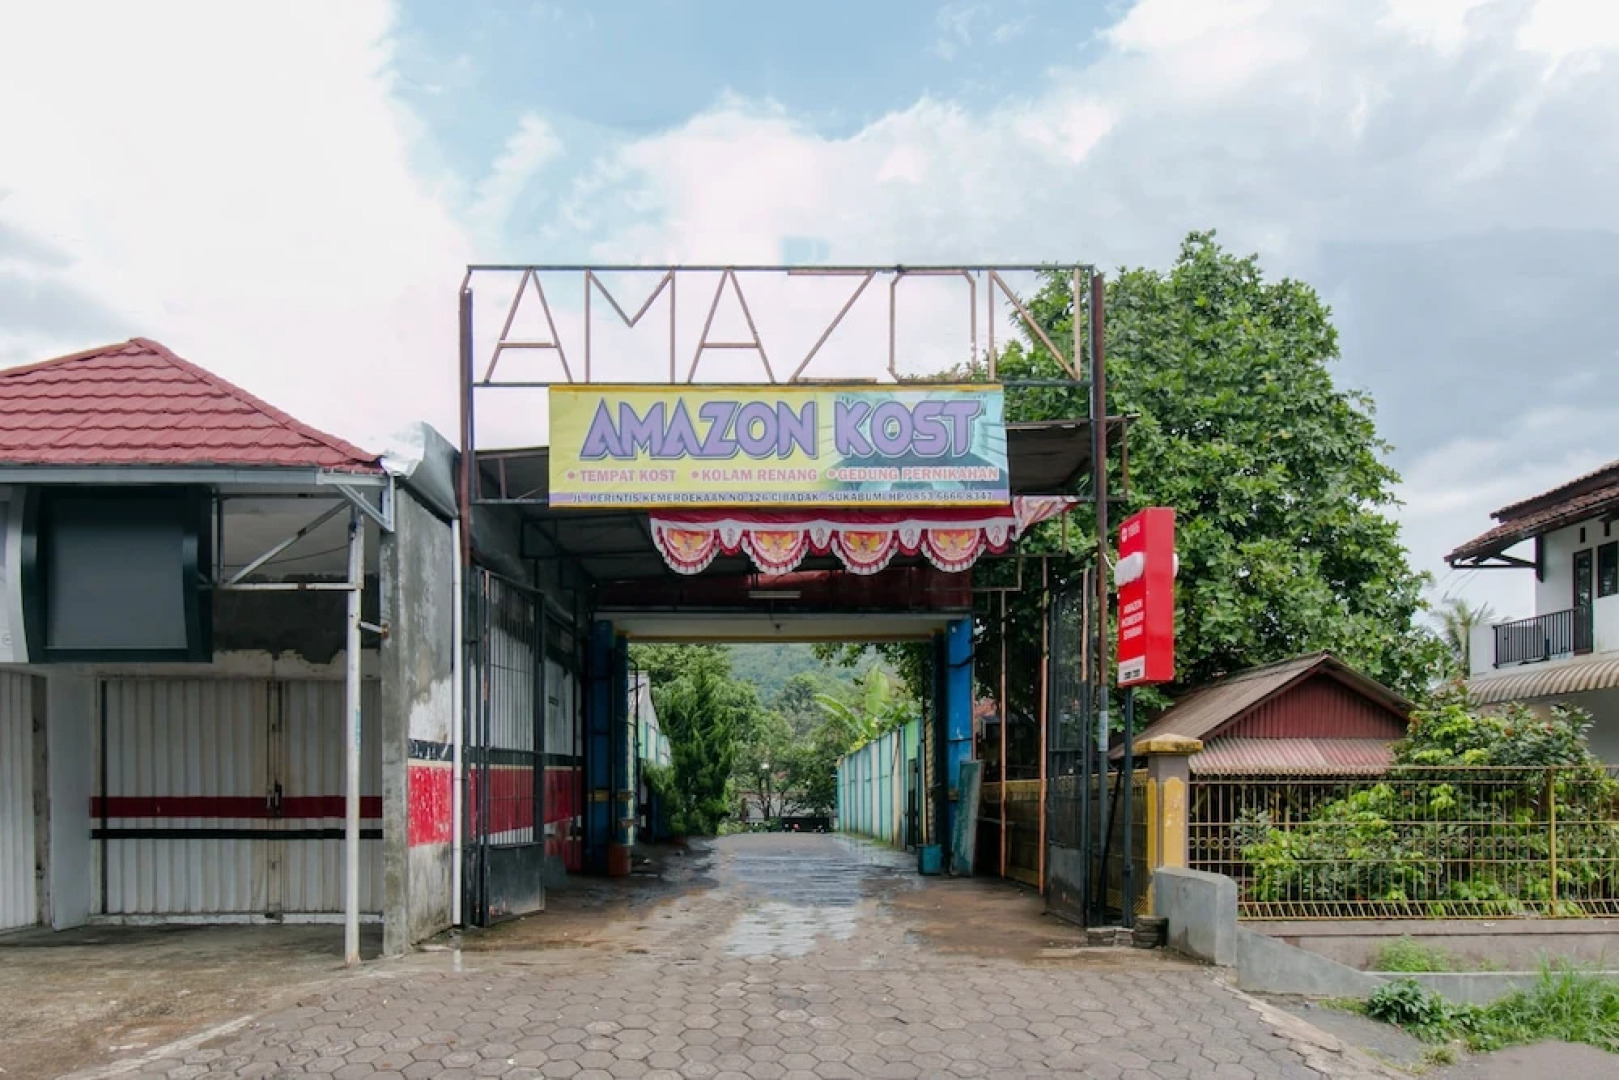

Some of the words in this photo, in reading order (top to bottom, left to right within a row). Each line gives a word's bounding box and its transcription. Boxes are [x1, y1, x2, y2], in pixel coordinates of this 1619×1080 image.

[483, 266, 1081, 384] AMAZON
[580, 398, 818, 460] AMAZON
[834, 400, 982, 459] KOST
[581, 469, 635, 482] TEMPAT
[639, 469, 676, 482] KOST
[702, 468, 752, 481] KOLAM
[757, 468, 817, 481] RENANG
[838, 467, 898, 481] GEDUNG
[903, 467, 998, 481] PERNIKAHAN
